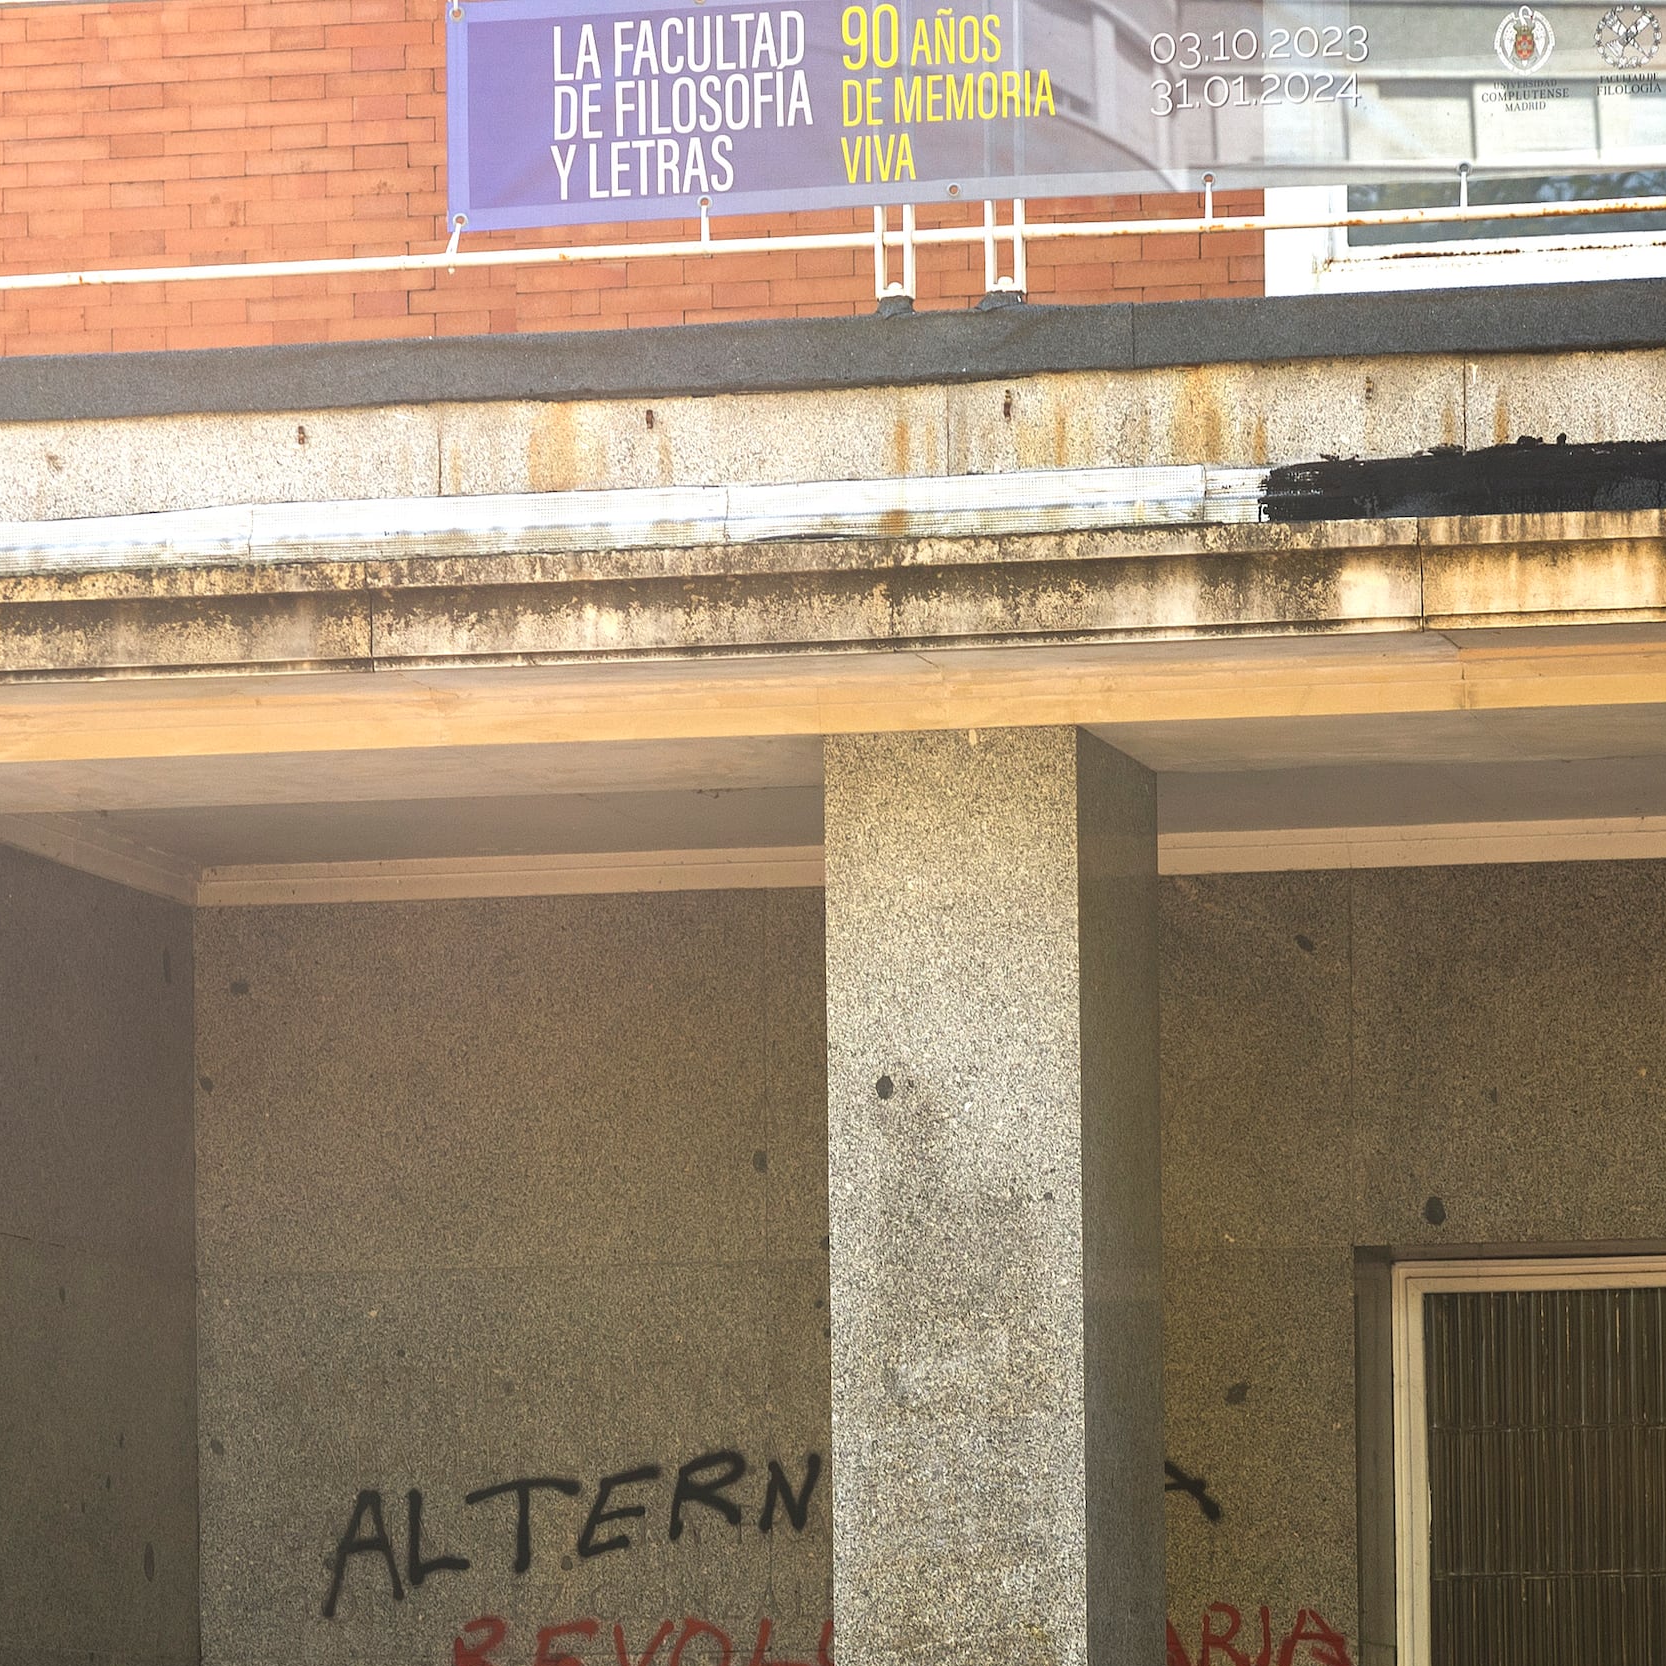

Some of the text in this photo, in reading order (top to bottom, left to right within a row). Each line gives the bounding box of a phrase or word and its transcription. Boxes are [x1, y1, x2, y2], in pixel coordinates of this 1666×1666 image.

[553, 10, 806, 82] LA FACULTAD
[841, 4, 1002, 71] 90 AÑOS
[1150, 24, 1369, 70] 03.10.2023
[554, 56, 813, 141] DE FILOSOFÍA
[842, 69, 1056, 128] DE MEMORIA
[1150, 71, 1362, 117] 31.01.2024
[1481, 88, 1570, 103] COMPLUTENSE
[1493, 78, 1558, 90] UNIVERSIDAD
[1596, 81, 1662, 97] FILOLOGÍA
[1599, 72, 1660, 84] FACULTAD DE
[1505, 100, 1546, 113] MADRID
[550, 134, 734, 201] Y LETRAS
[840, 132, 916, 184] VIVA
